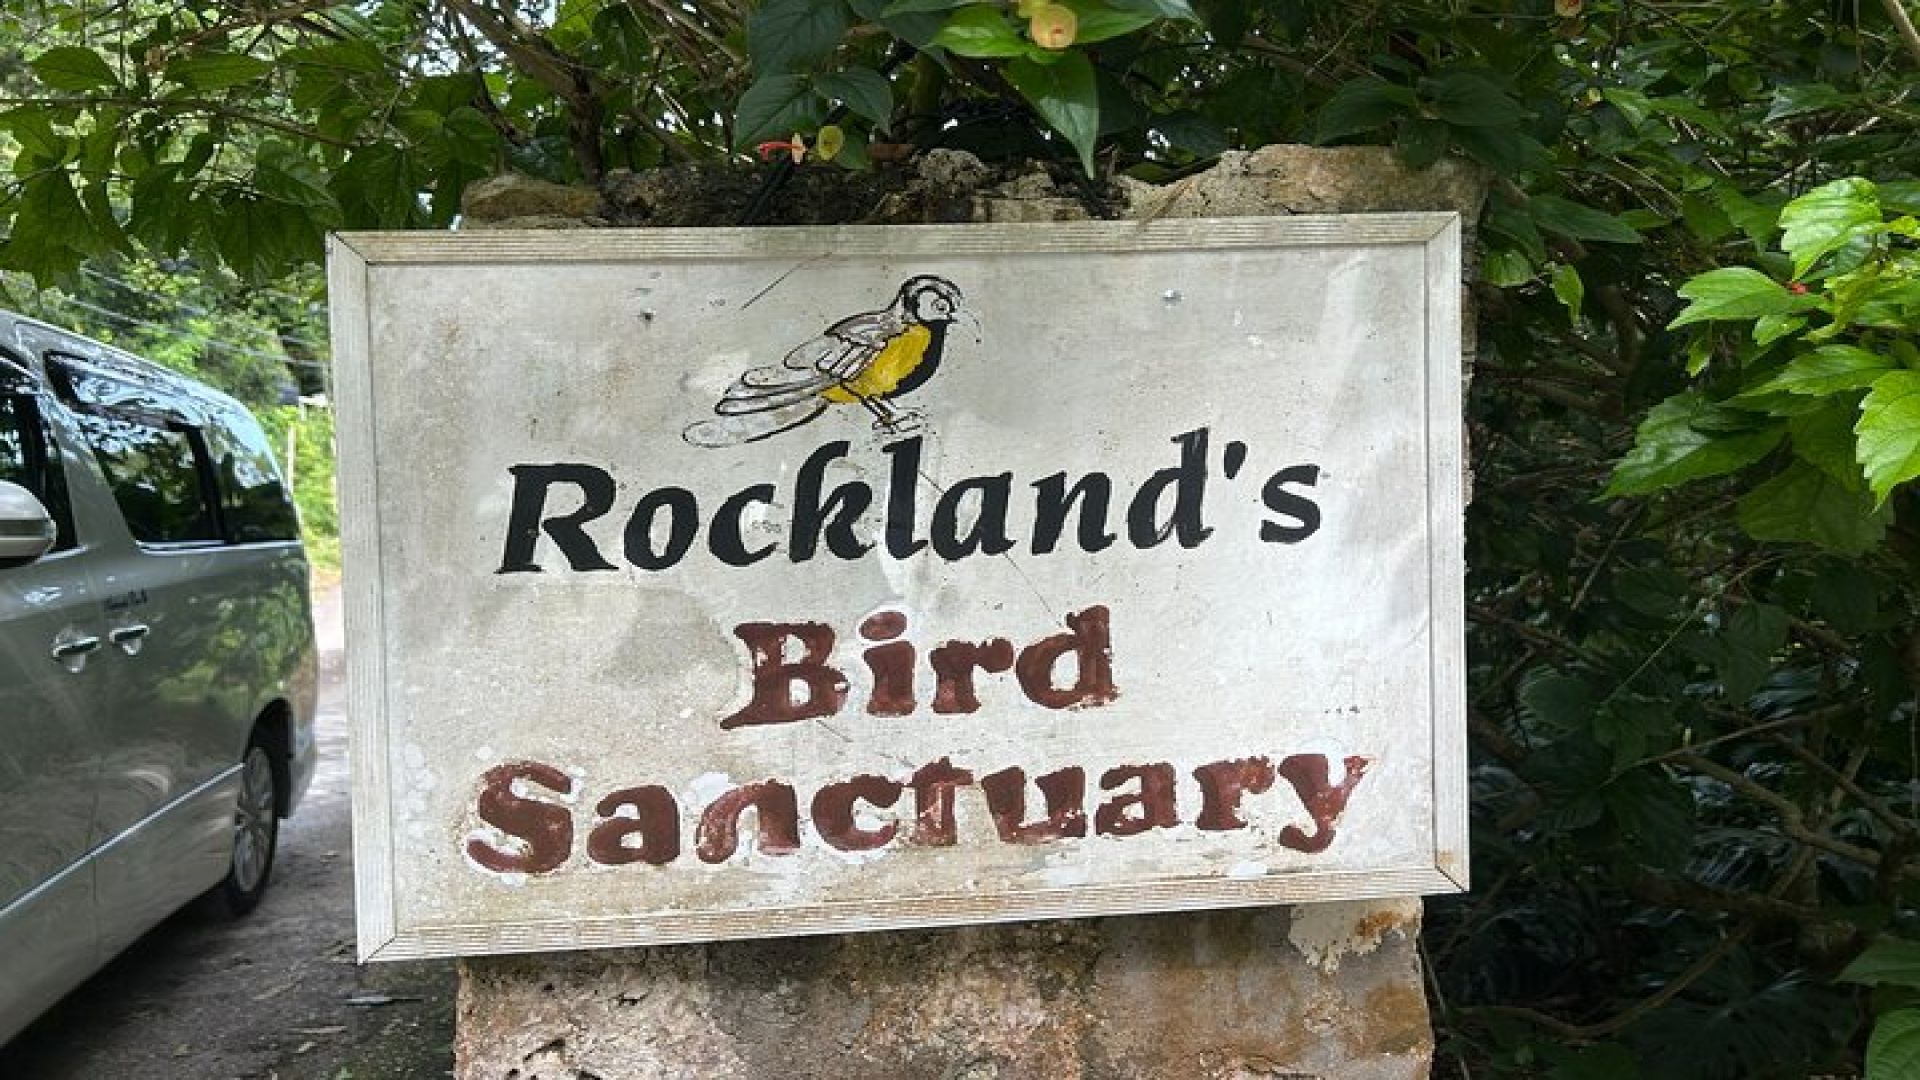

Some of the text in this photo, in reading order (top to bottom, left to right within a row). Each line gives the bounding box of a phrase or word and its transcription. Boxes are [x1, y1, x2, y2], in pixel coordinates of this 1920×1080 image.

[496, 427, 1322, 574] Rockland's
[719, 604, 1120, 730] Bird
[466, 752, 1369, 874] Sanctuary
